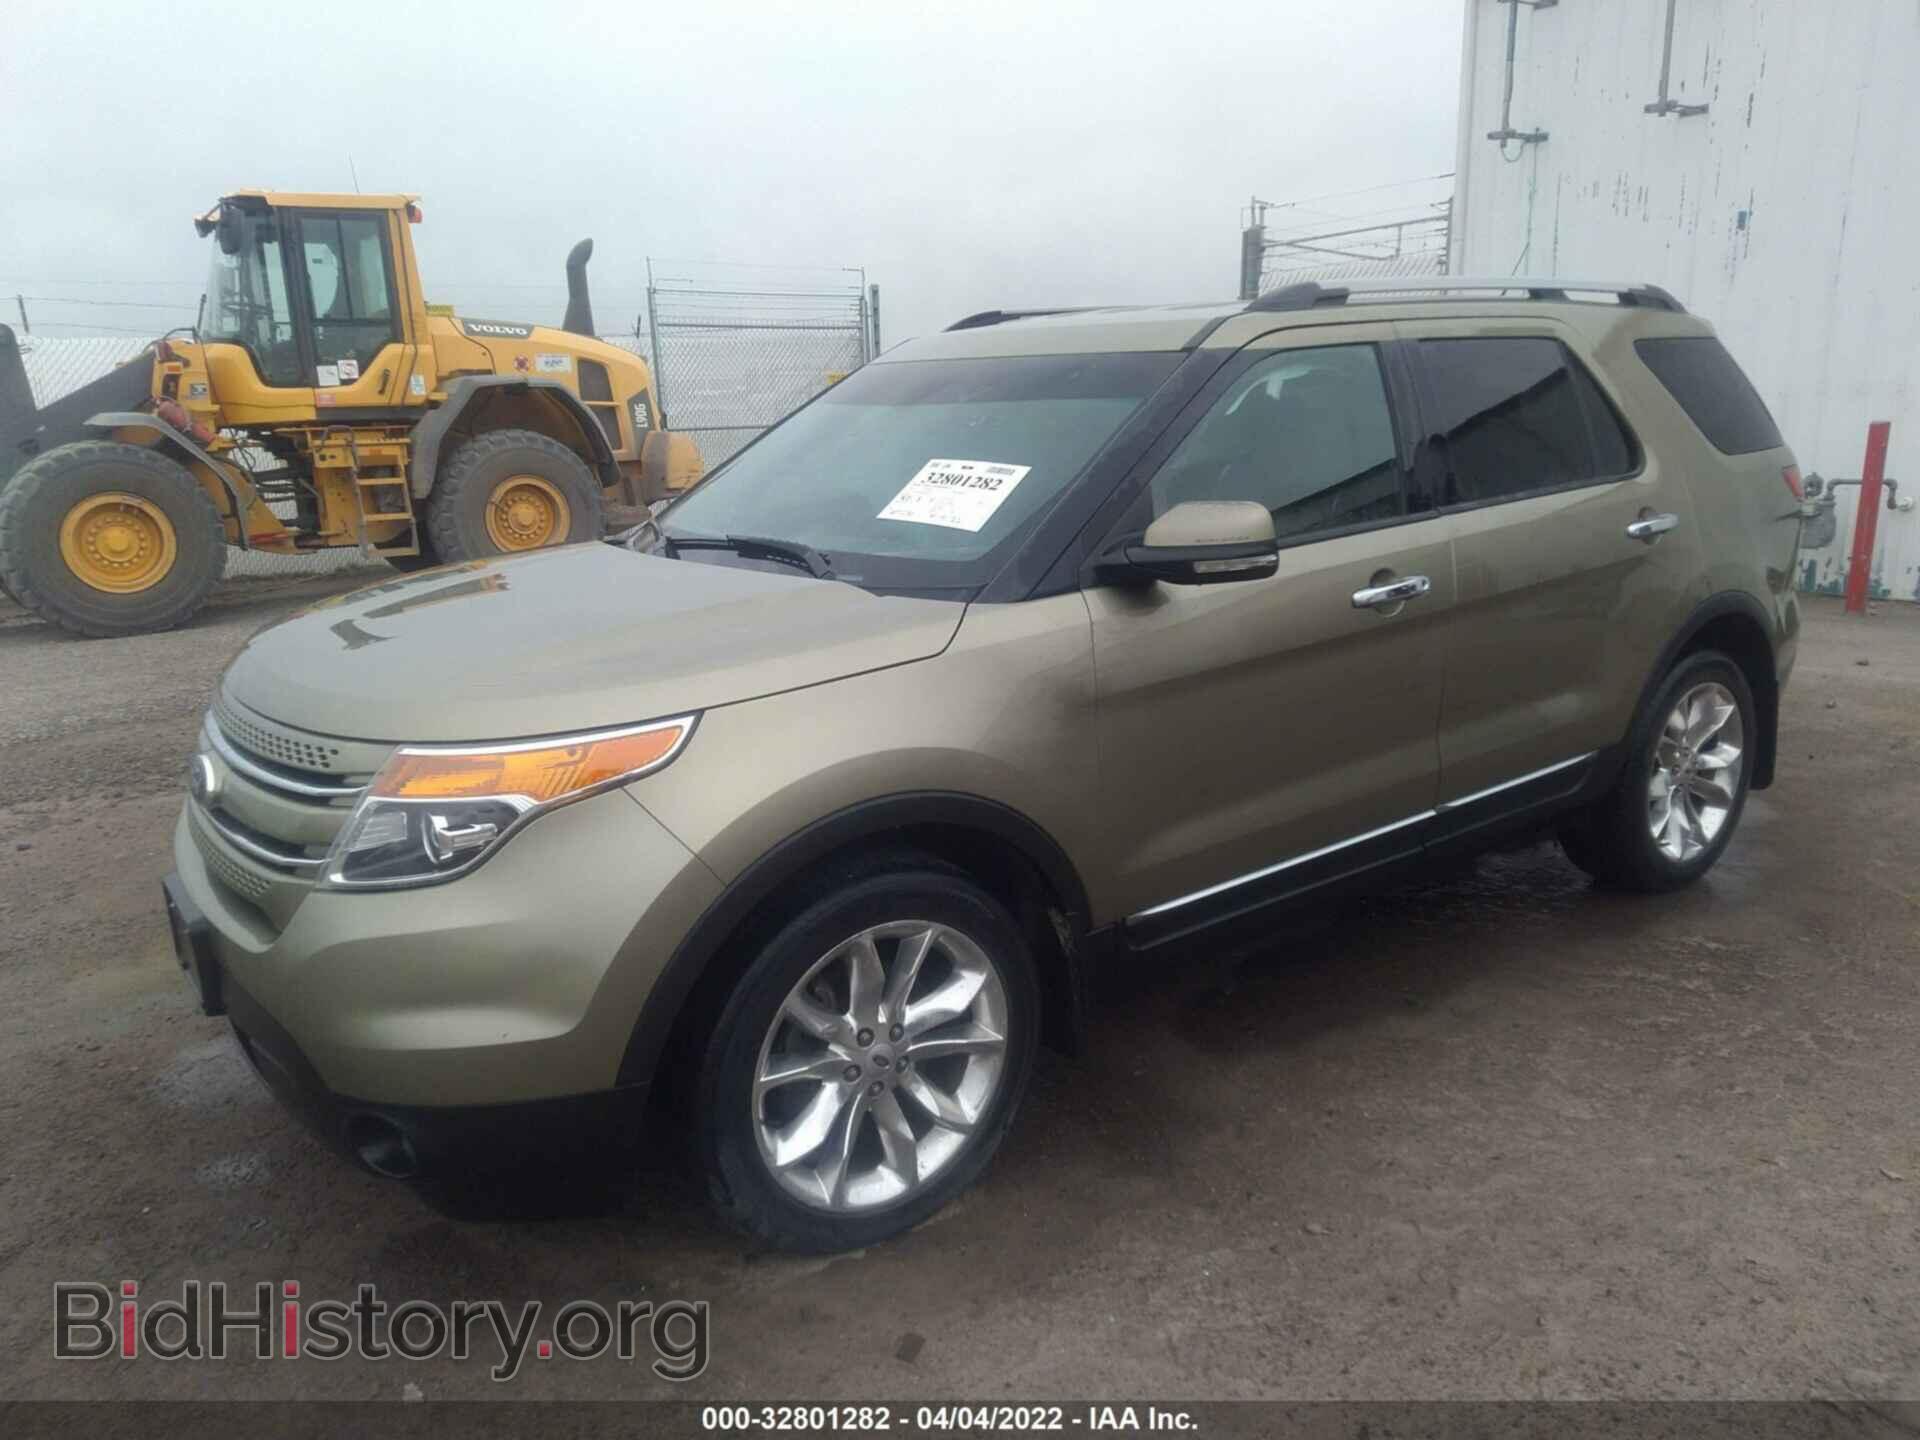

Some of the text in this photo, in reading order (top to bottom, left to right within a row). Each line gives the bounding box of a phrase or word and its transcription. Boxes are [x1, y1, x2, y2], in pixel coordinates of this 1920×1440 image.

[467, 322, 528, 336] VOLVO
[634, 402, 648, 428] L90G
[921, 471, 1003, 491] 32801282
